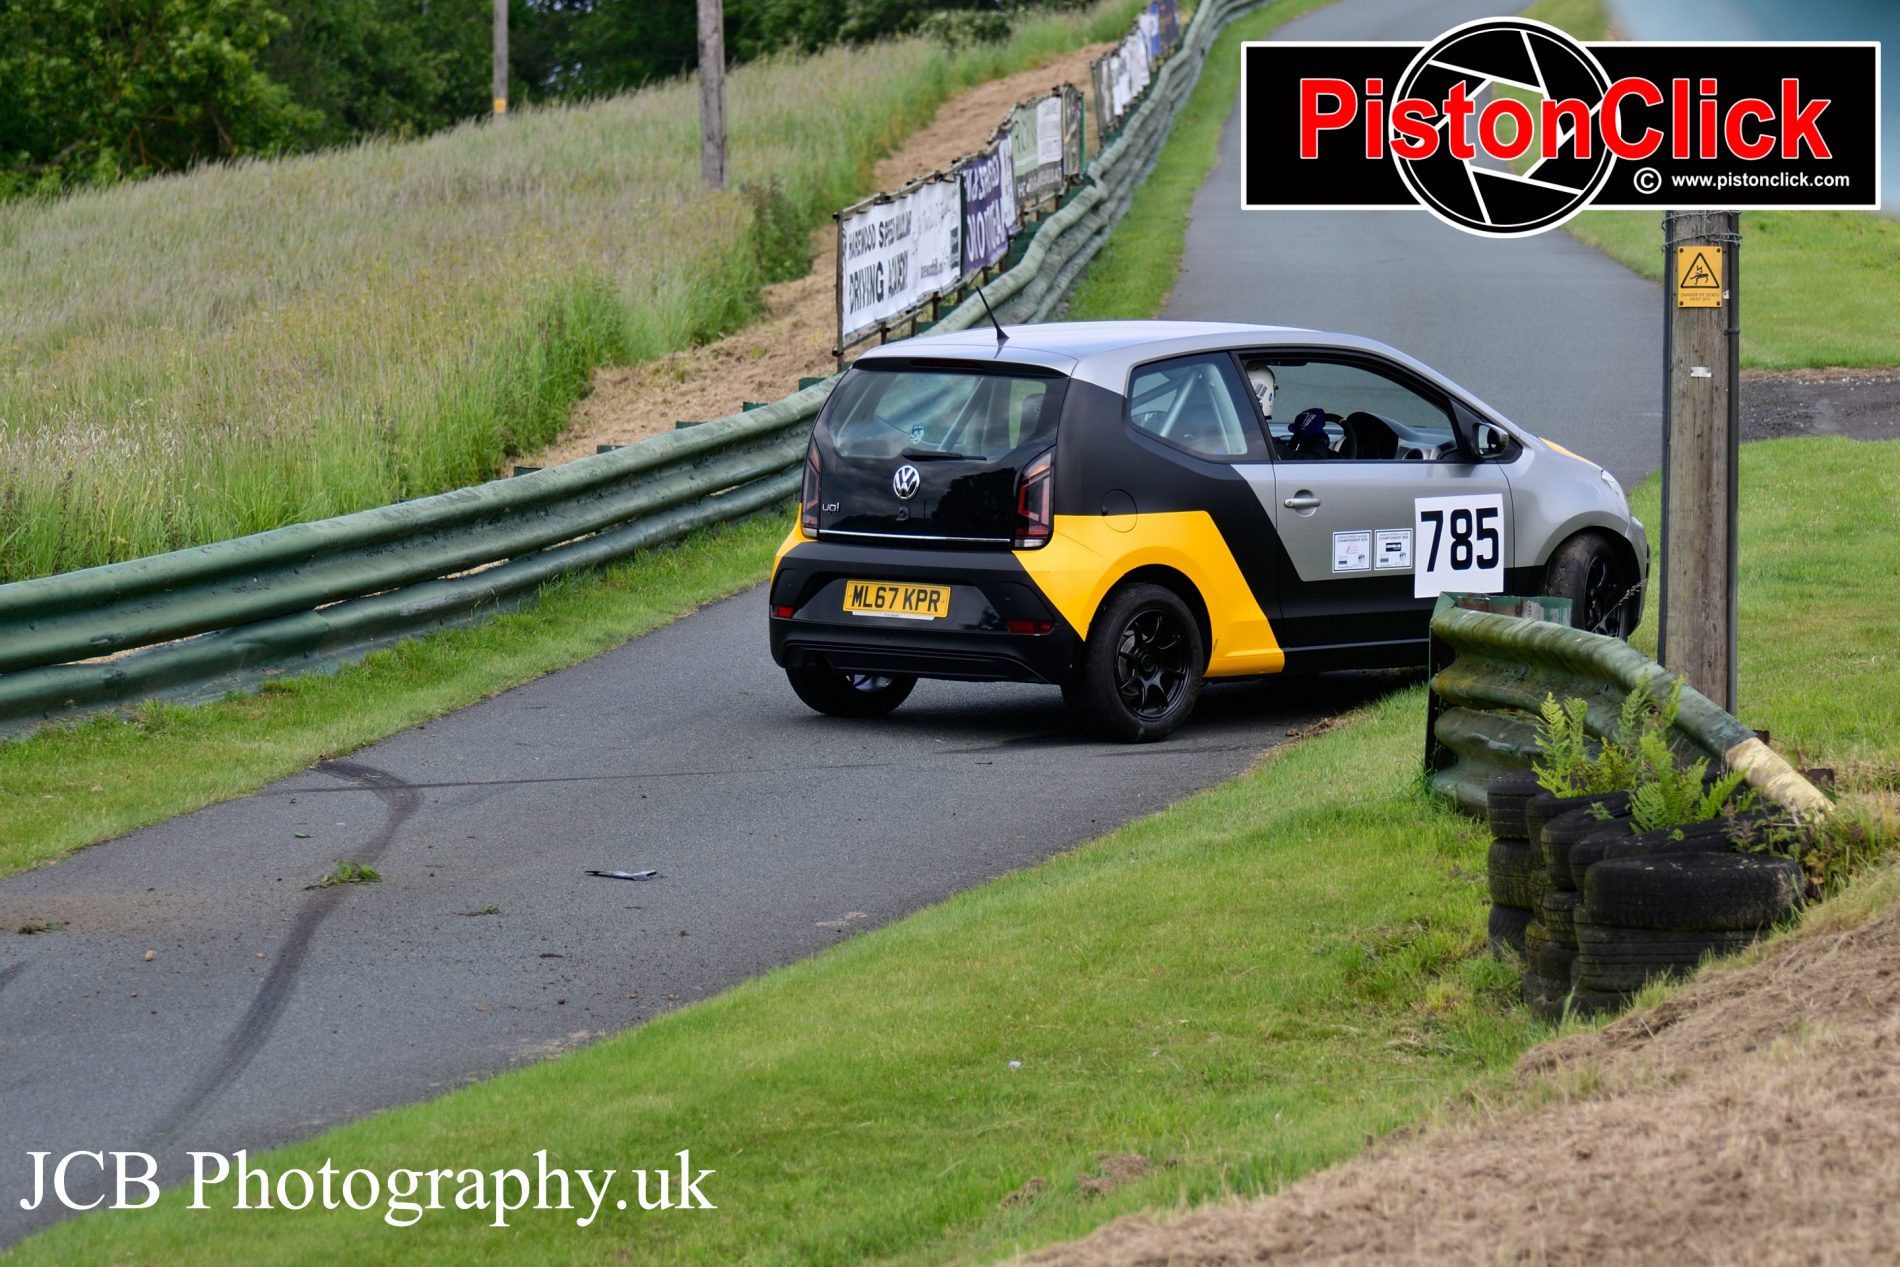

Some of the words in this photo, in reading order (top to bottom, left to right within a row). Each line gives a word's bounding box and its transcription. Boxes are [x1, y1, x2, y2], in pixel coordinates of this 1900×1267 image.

[849, 261, 884, 315] DRIVING
[1420, 506, 1499, 573] 785
[851, 585, 898, 609] ML67
[902, 588, 941, 612] KPR
